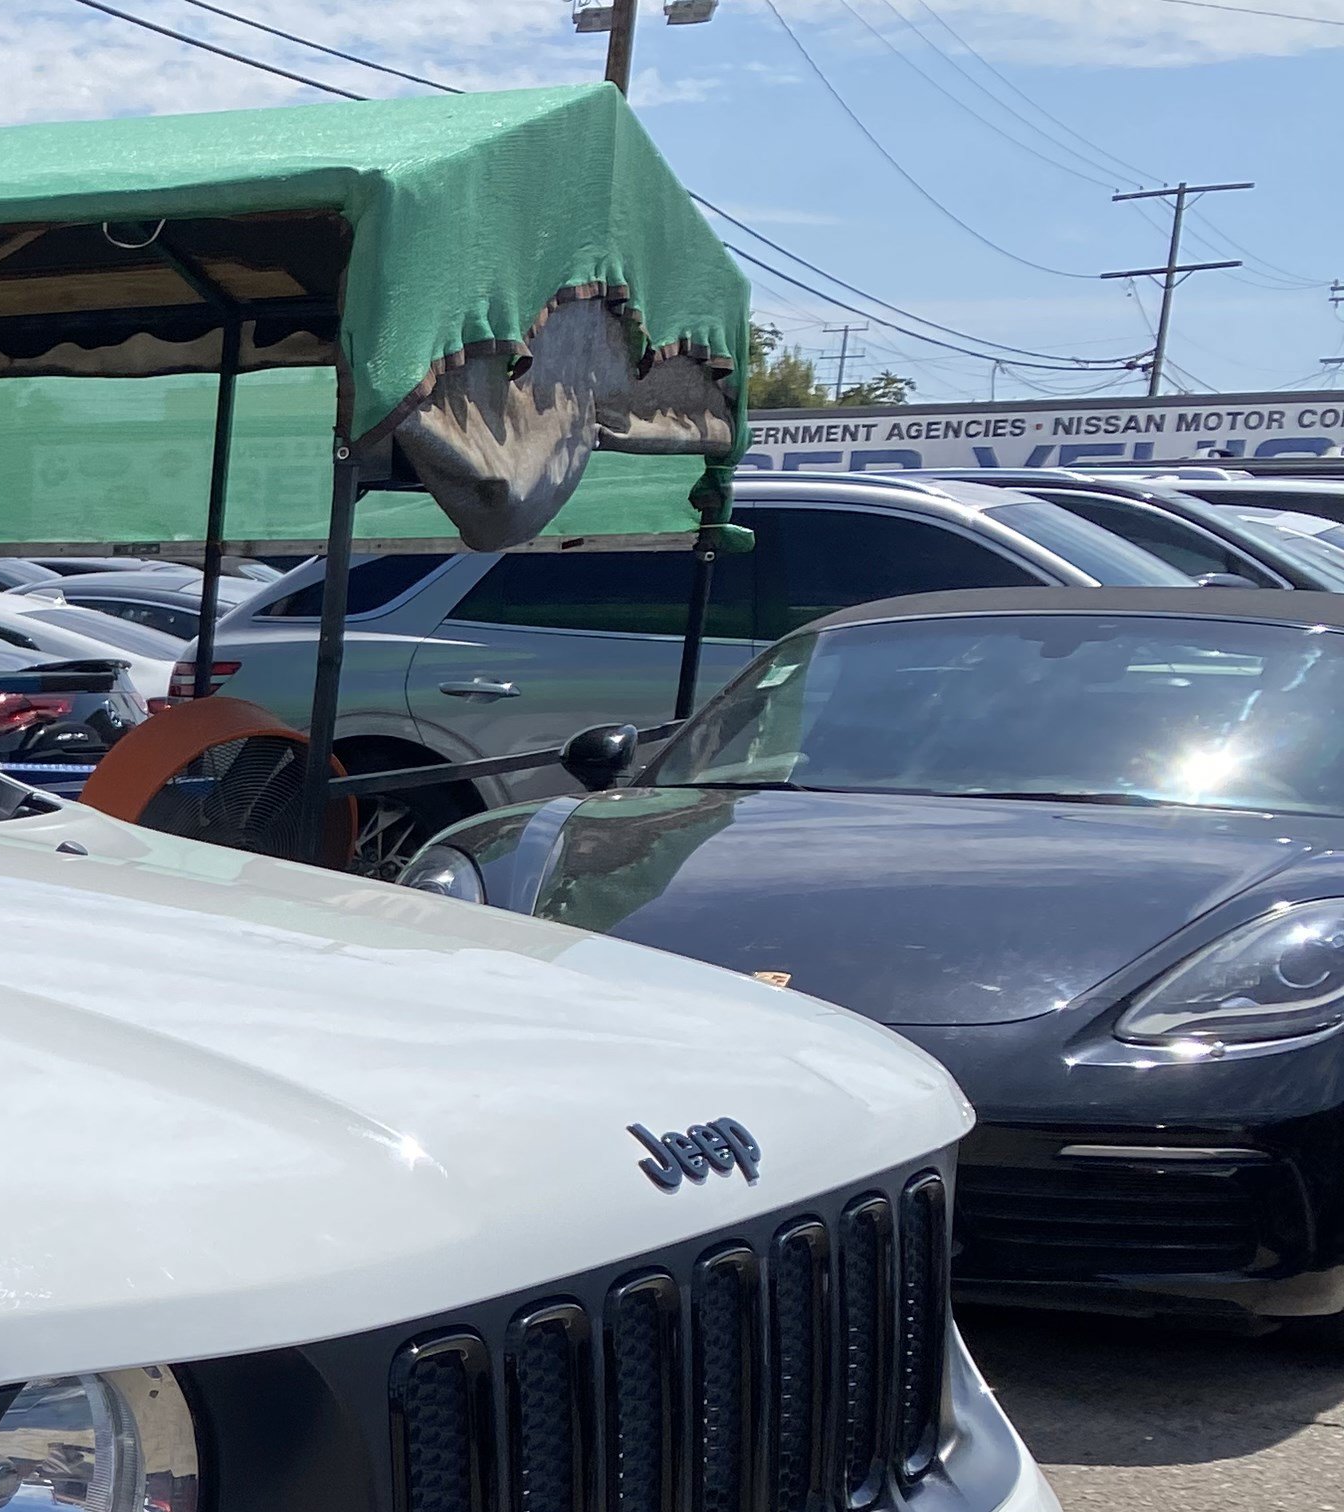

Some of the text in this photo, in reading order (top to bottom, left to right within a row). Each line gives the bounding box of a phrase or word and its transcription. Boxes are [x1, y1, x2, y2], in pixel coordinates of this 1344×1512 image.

[751, 408, 1344, 445] ERNMENT AGENCIES NISSAN MOTOR CO
[626, 1117, 761, 1190] Jeep
